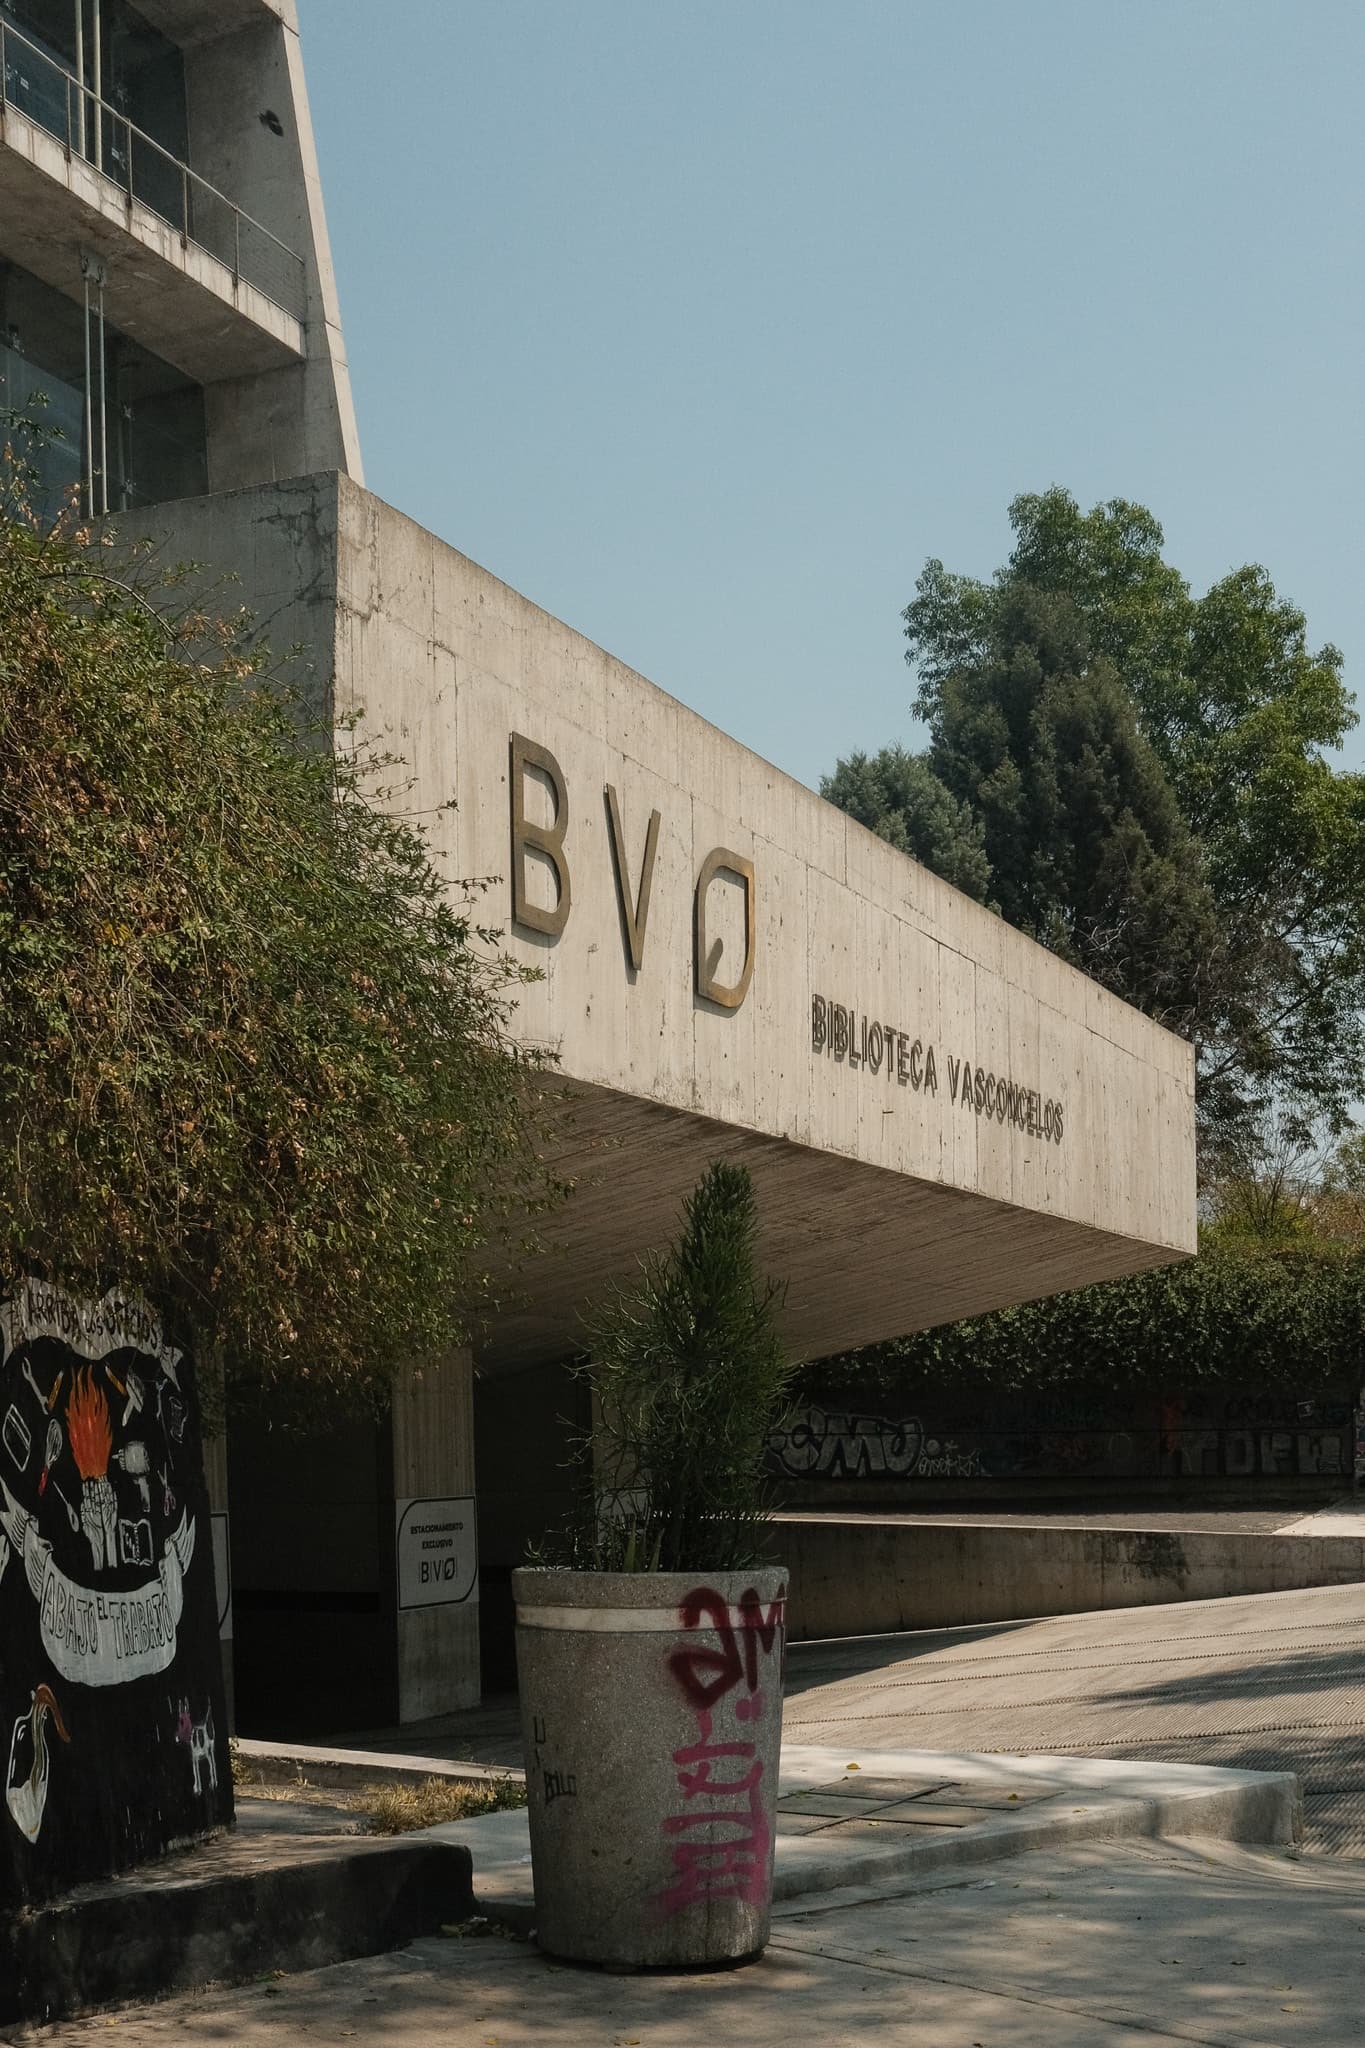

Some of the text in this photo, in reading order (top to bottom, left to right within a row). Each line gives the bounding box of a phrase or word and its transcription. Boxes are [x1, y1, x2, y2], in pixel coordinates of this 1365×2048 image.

[811, 993, 1064, 1145] BIBLIOTECA VASCONCELOS
[42, 1572, 174, 1659] ABAJO EL TRABAJO
